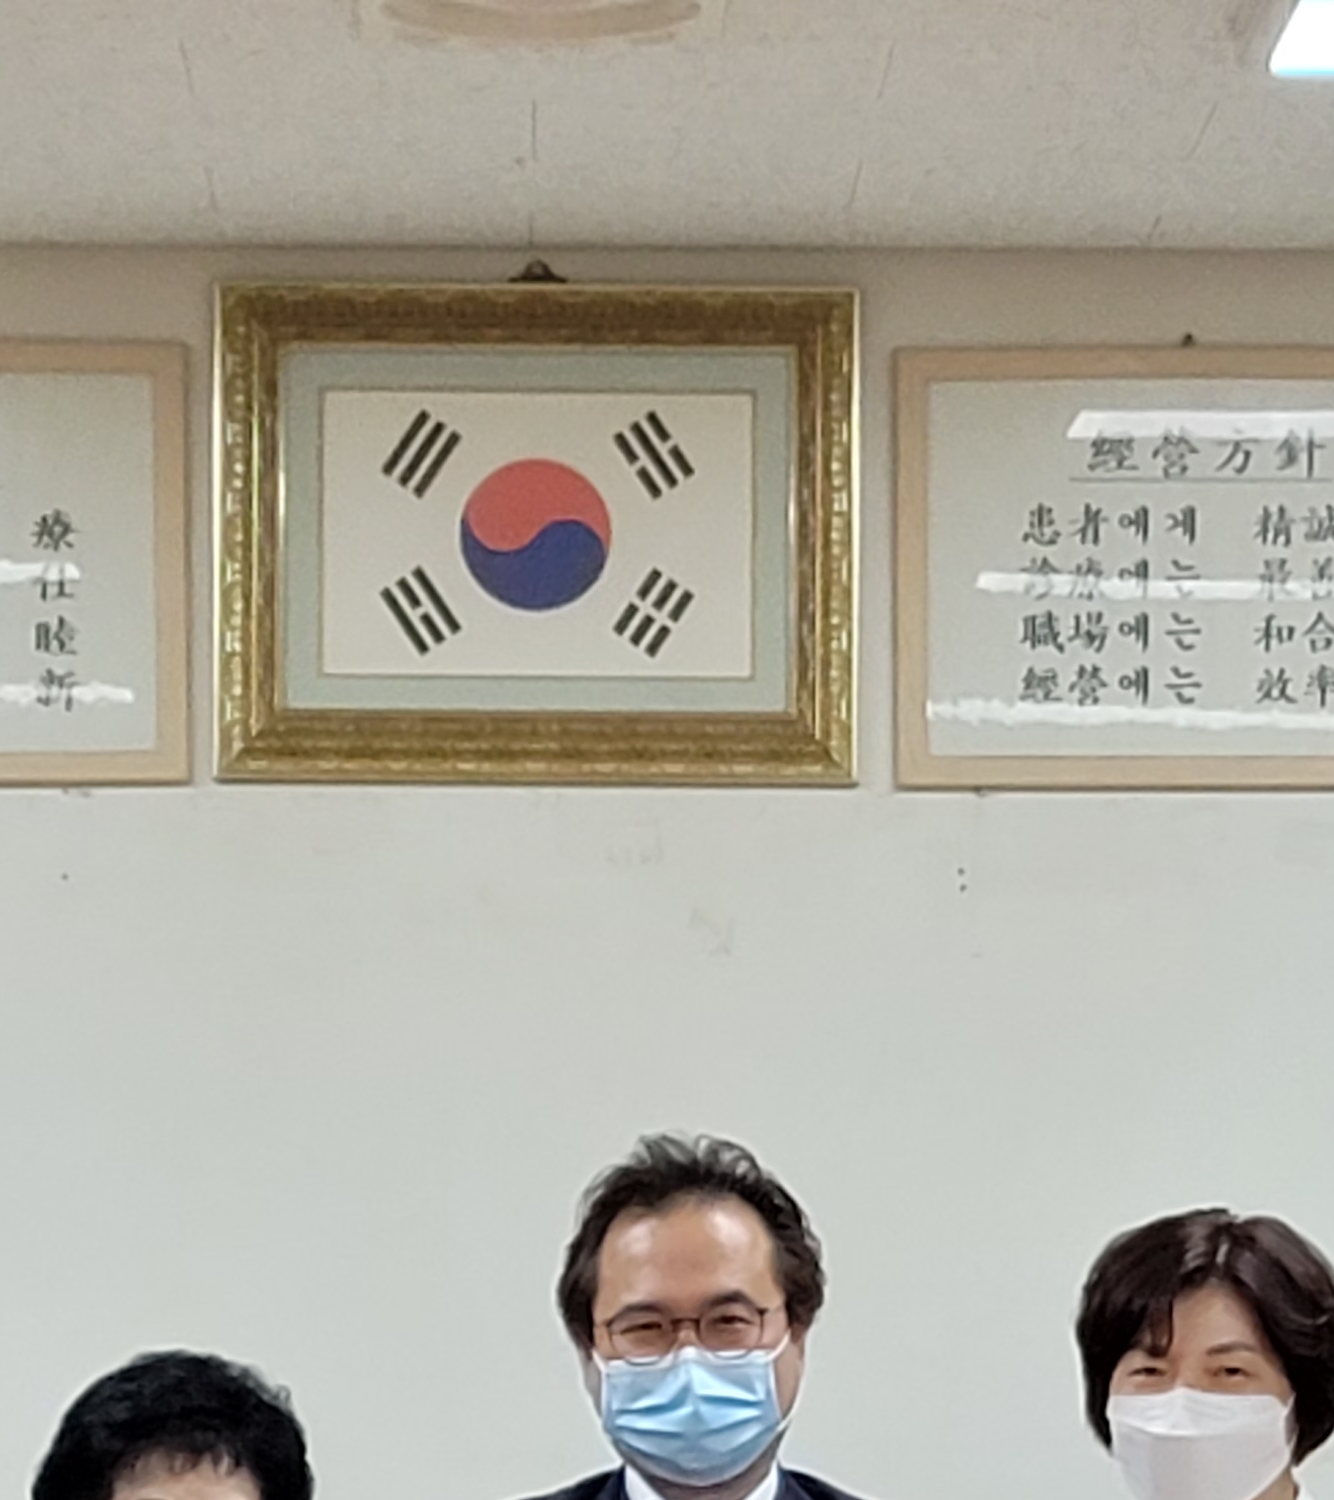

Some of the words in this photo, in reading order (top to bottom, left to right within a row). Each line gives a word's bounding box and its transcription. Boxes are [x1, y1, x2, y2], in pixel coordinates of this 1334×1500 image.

[1021, 502, 1197, 547] 患者에게
[1019, 609, 1202, 654] 職場에는
[1019, 664, 1203, 707] 經營에는
